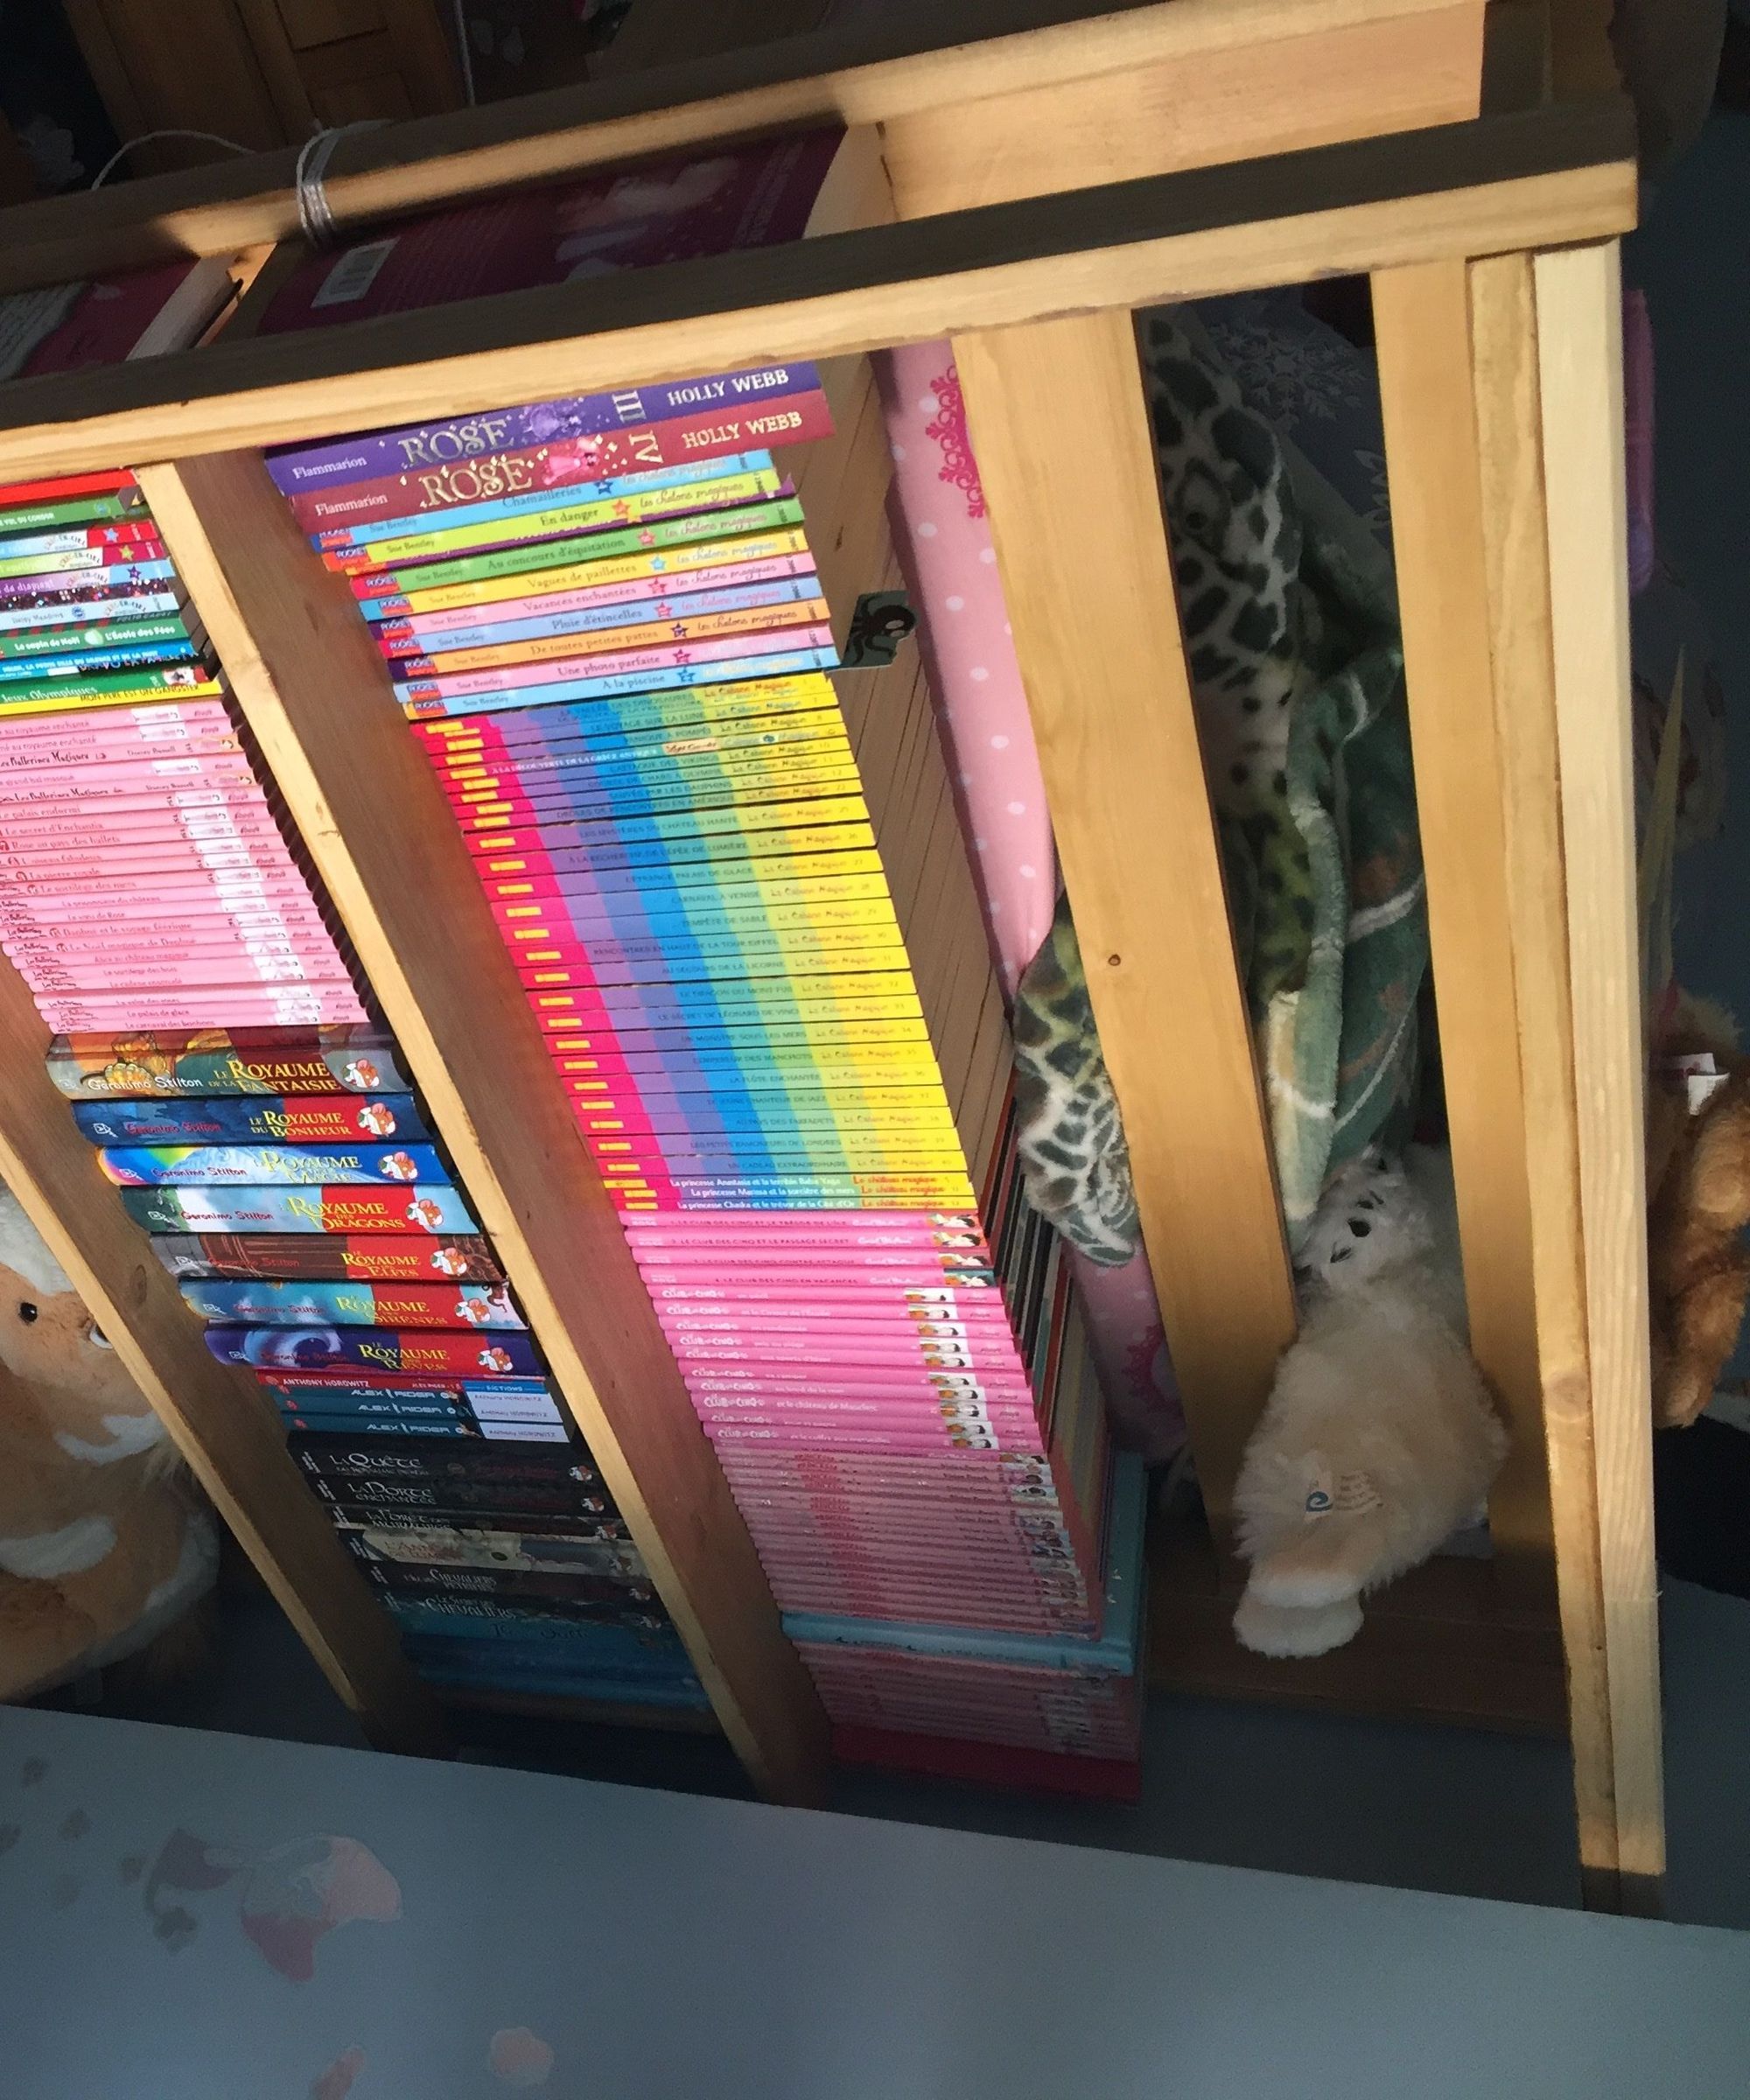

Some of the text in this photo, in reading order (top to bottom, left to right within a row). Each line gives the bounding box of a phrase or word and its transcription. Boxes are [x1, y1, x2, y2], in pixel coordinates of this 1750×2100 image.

[291, 454, 368, 480] Flammarion
[397, 418, 514, 468] ROSE
[668, 382, 727, 407] HOLLY
[734, 368, 790, 393] WEBB
[315, 494, 388, 516] Flammarion
[418, 457, 533, 507] ROSE
[682, 423, 741, 449] HOLLY
[746, 410, 802, 435] WEBB
[540, 515, 557, 527] En
[560, 508, 598, 523] danger
[506, 551, 555, 568] concours
[26, 639, 49, 651] sapin
[584, 661, 616, 676] photo
[618, 654, 661, 670] parfaite
[627, 674, 666, 688] piscine
[29, 686, 98, 701] Olympiques
[228, 1058, 330, 1082] ROYAUME
[88, 1075, 342, 1092] Geronimo Stilton FANTAISIE
[262, 1110, 346, 1126] ROYAUME
[125, 1122, 180, 1135] Geronimo
[181, 1120, 221, 1133] Stilton
[270, 1124, 354, 1138] BONHEUR
[260, 1150, 362, 1172] ROYAUME
[152, 1165, 248, 1179] Geronimo Stilton
[287, 1196, 389, 1216] ROYAUME
[181, 1209, 407, 1230] Geronimo Stilton DRAGONS
[340, 1251, 421, 1267] ROYAUME
[335, 1295, 430, 1312] ROYAUME
[358, 1343, 449, 1361] ROYAUME
[283, 1377, 370, 1388] ANTHONY HOROWITZ
[351, 1389, 437, 1399] ALEX RIDER
[358, 1404, 390, 1413] ALEX
[367, 1422, 450, 1433] ALEX RIDER
